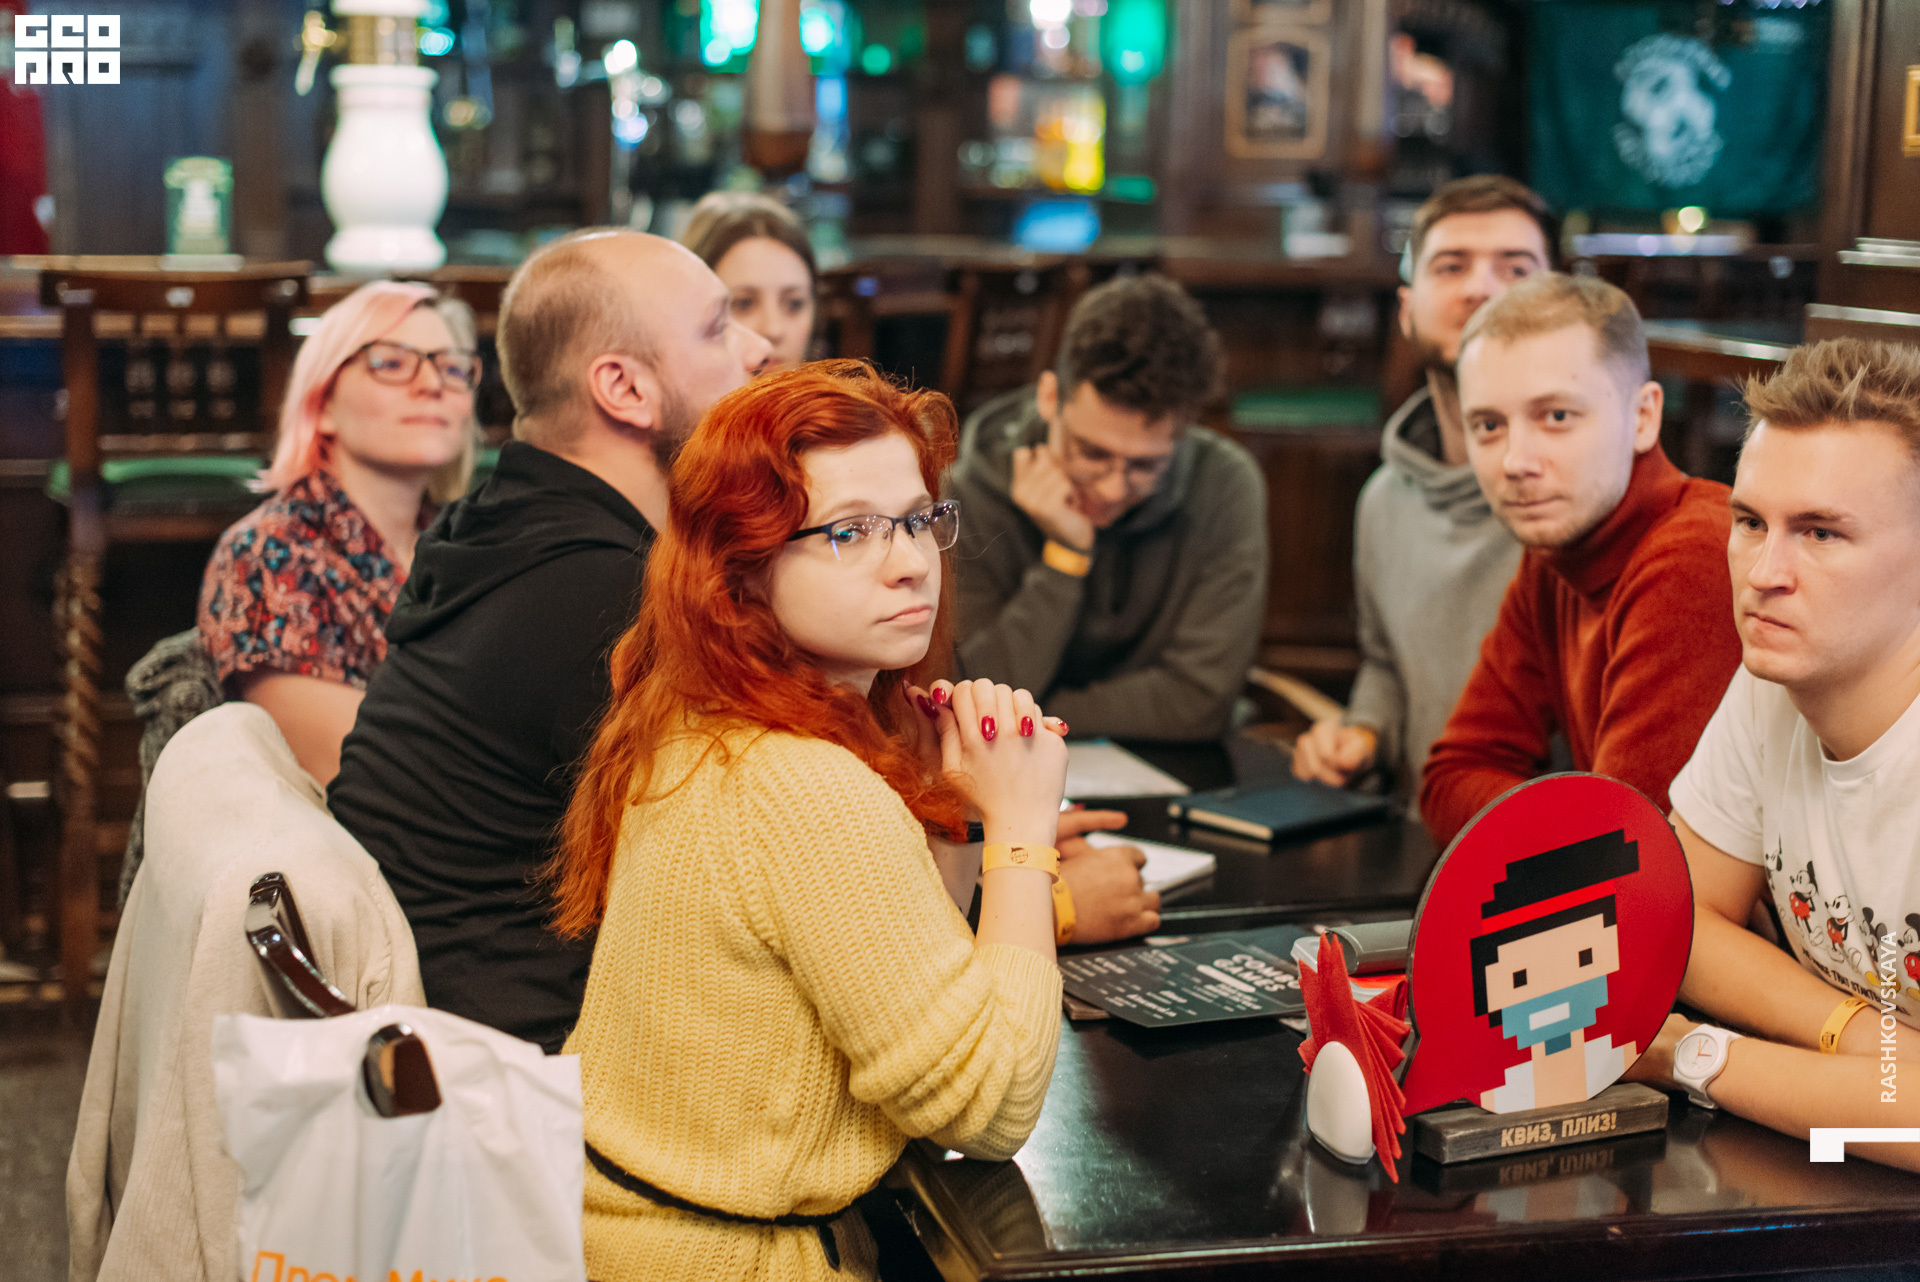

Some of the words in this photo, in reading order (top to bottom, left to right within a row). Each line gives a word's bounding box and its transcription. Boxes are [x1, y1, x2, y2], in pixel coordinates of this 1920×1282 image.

[1213, 959, 1285, 992] GAMES
[1501, 1122, 1556, 1148] КВИЗ,
[1561, 1111, 1617, 1138] ПЛИЗ!
